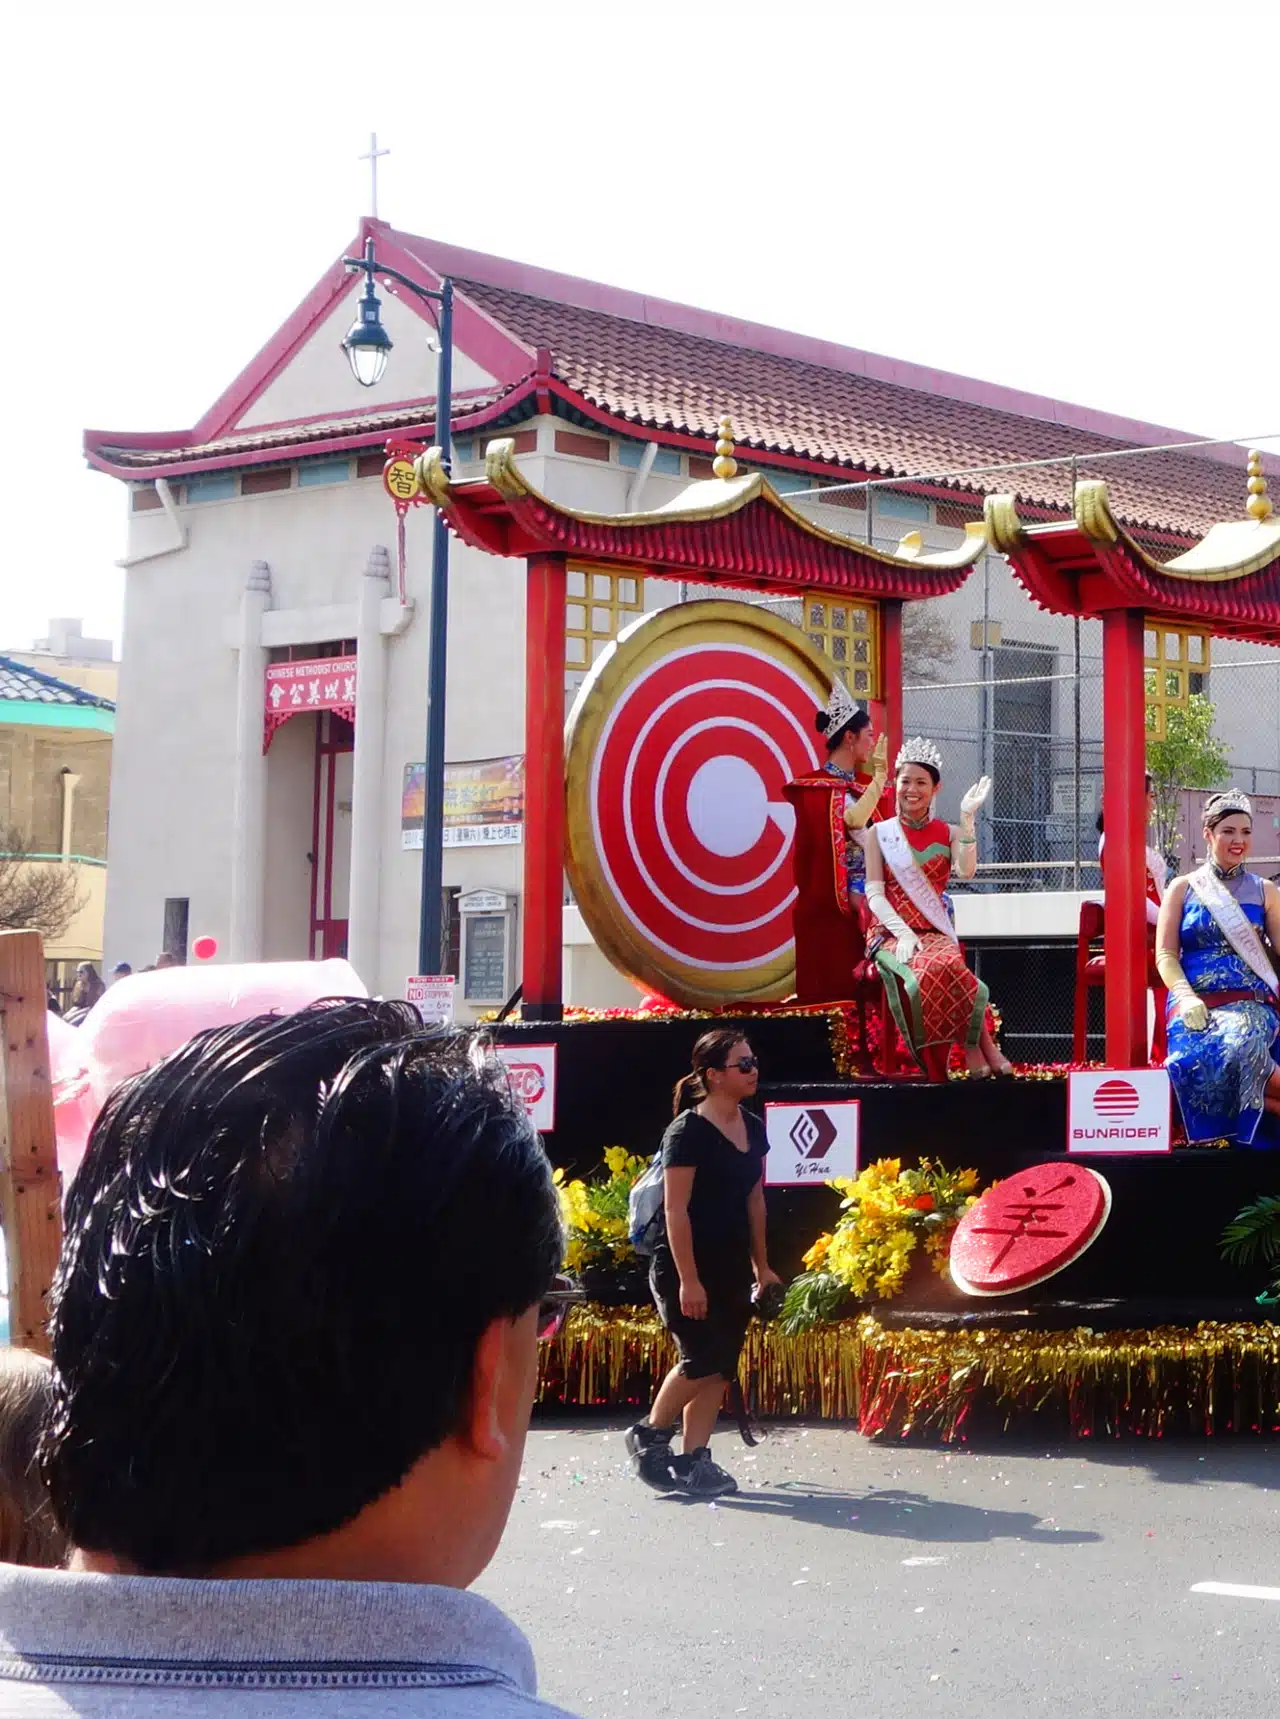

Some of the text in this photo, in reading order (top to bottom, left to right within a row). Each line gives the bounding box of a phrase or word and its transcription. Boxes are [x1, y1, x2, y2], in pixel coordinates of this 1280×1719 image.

[389, 466, 416, 495] 智
[267, 661, 356, 680] CHINESE METHODIST CHURC
[408, 988, 423, 1000] NO
[1073, 1127, 1159, 1139] SUNRIDER
[969, 1175, 1077, 1274] 羊
